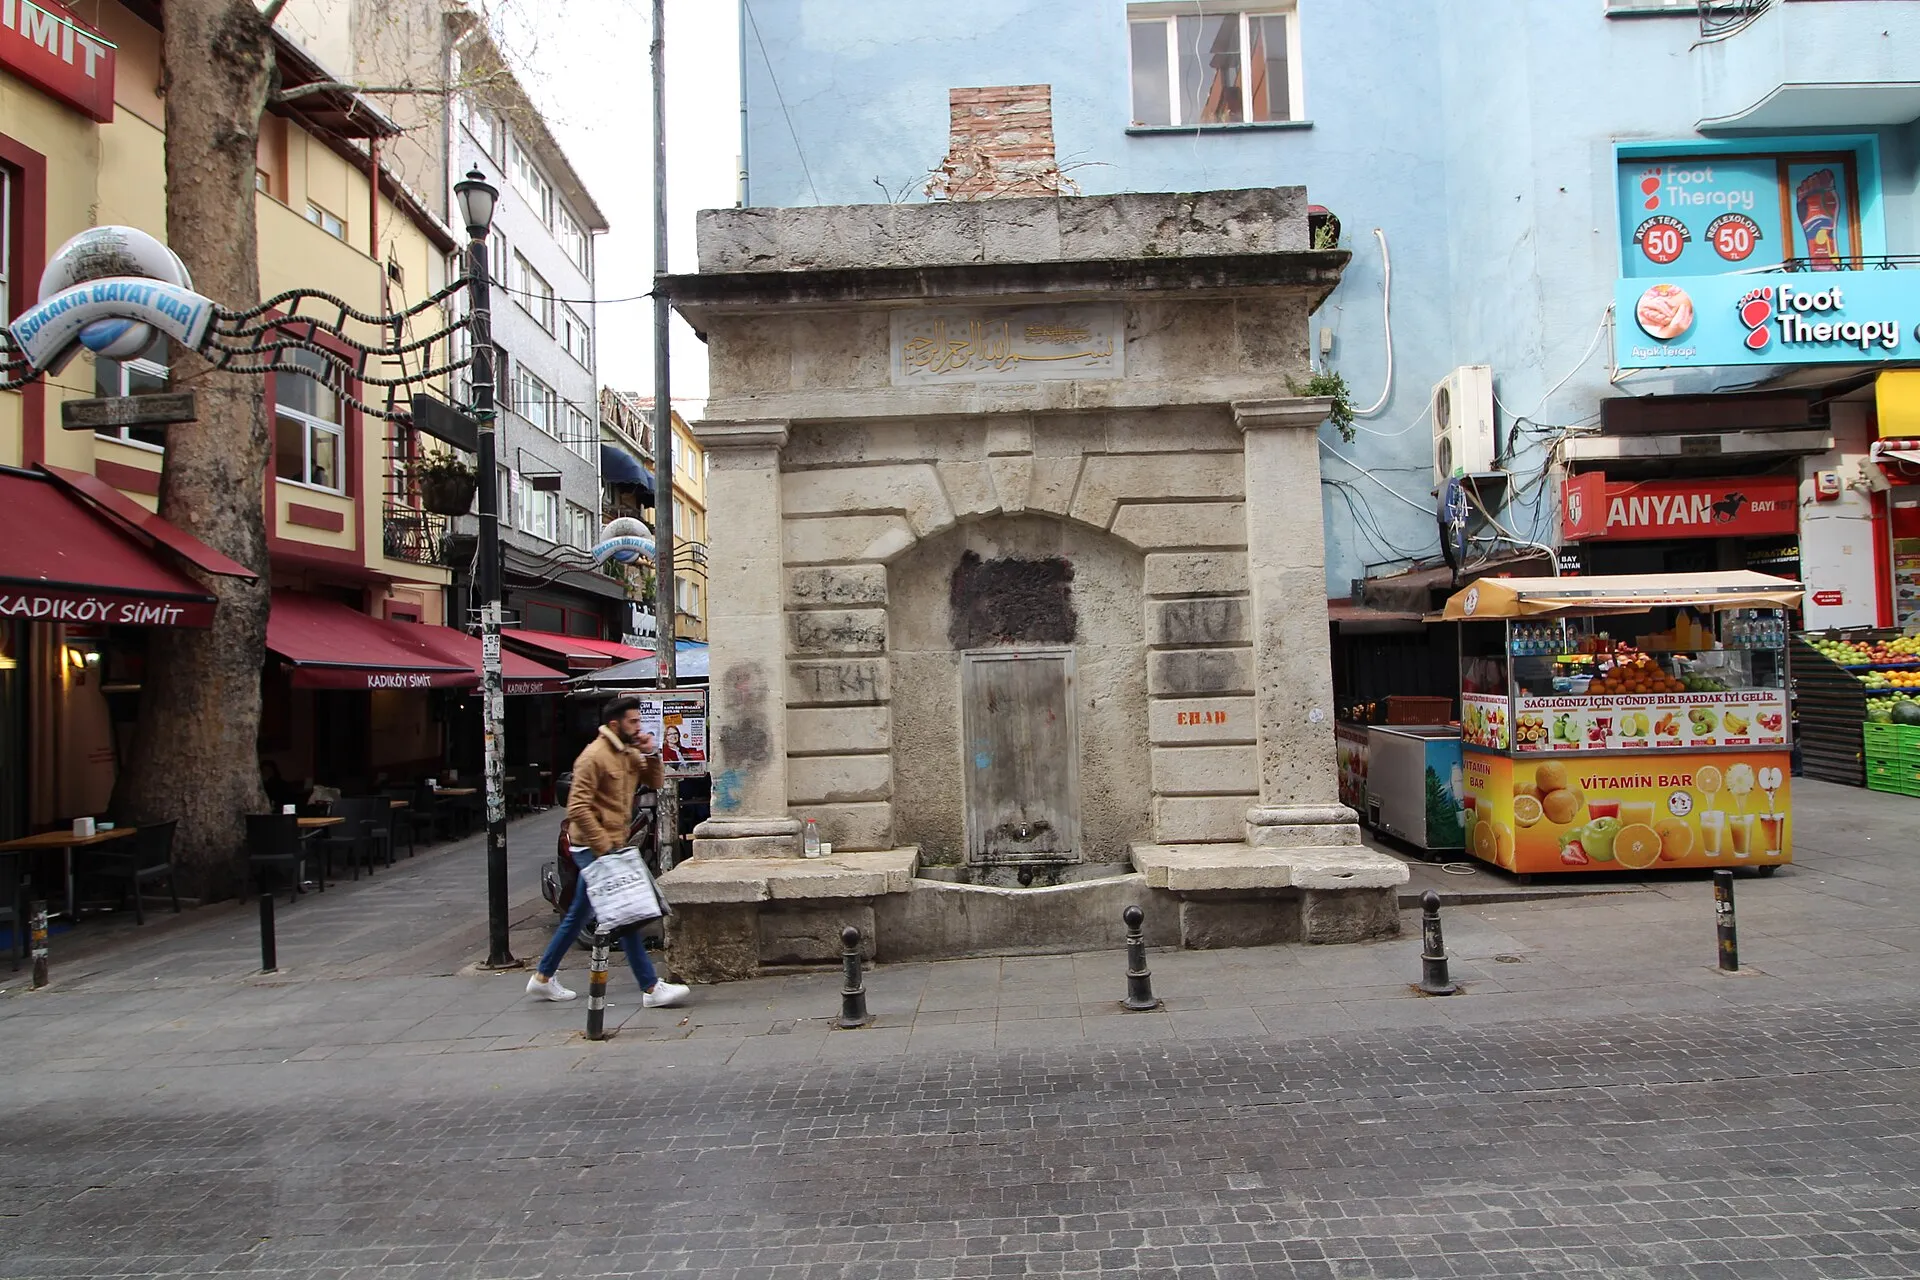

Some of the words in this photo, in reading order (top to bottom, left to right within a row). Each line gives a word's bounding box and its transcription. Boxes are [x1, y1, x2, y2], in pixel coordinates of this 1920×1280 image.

[1667, 165, 1714, 185] Foot
[1666, 186, 1754, 211] Therapy
[1636, 218, 1657, 239] AYAK
[1707, 215, 1760, 239] REFLEXOLOGY
[1648, 230, 1678, 254] 50
[1720, 228, 1749, 252] 50
[91, 284, 157, 303] HAYAT
[155, 294, 193, 325] VAR
[1779, 283, 1845, 312] Foot
[1777, 314, 1900, 349] Therapy
[1632, 345, 1661, 360] Ayak
[1662, 345, 1697, 360] Terapi
[0, 596, 115, 621] KADIKÖY
[119, 602, 184, 625] SİMİT
[367, 673, 407, 687] KADIKÖY
[409, 674, 431, 688] SİMİT
[507, 682, 530, 693] KADIKÖY
[1524, 697, 1588, 708] SAĞLIĞINIZ
[1590, 696, 1614, 709] İÇİN
[1616, 695, 1655, 706] GÜNDE
[1657, 694, 1677, 704] BİR
[1678, 693, 1723, 704] BARDAK
[1725, 692, 1739, 702] İYİ
[1741, 691, 1778, 702] GELİR.
[1469, 777, 1484, 789] BAR
[1580, 773, 1652, 790] VİTAMİN
[1658, 774, 1693, 787] BAR
